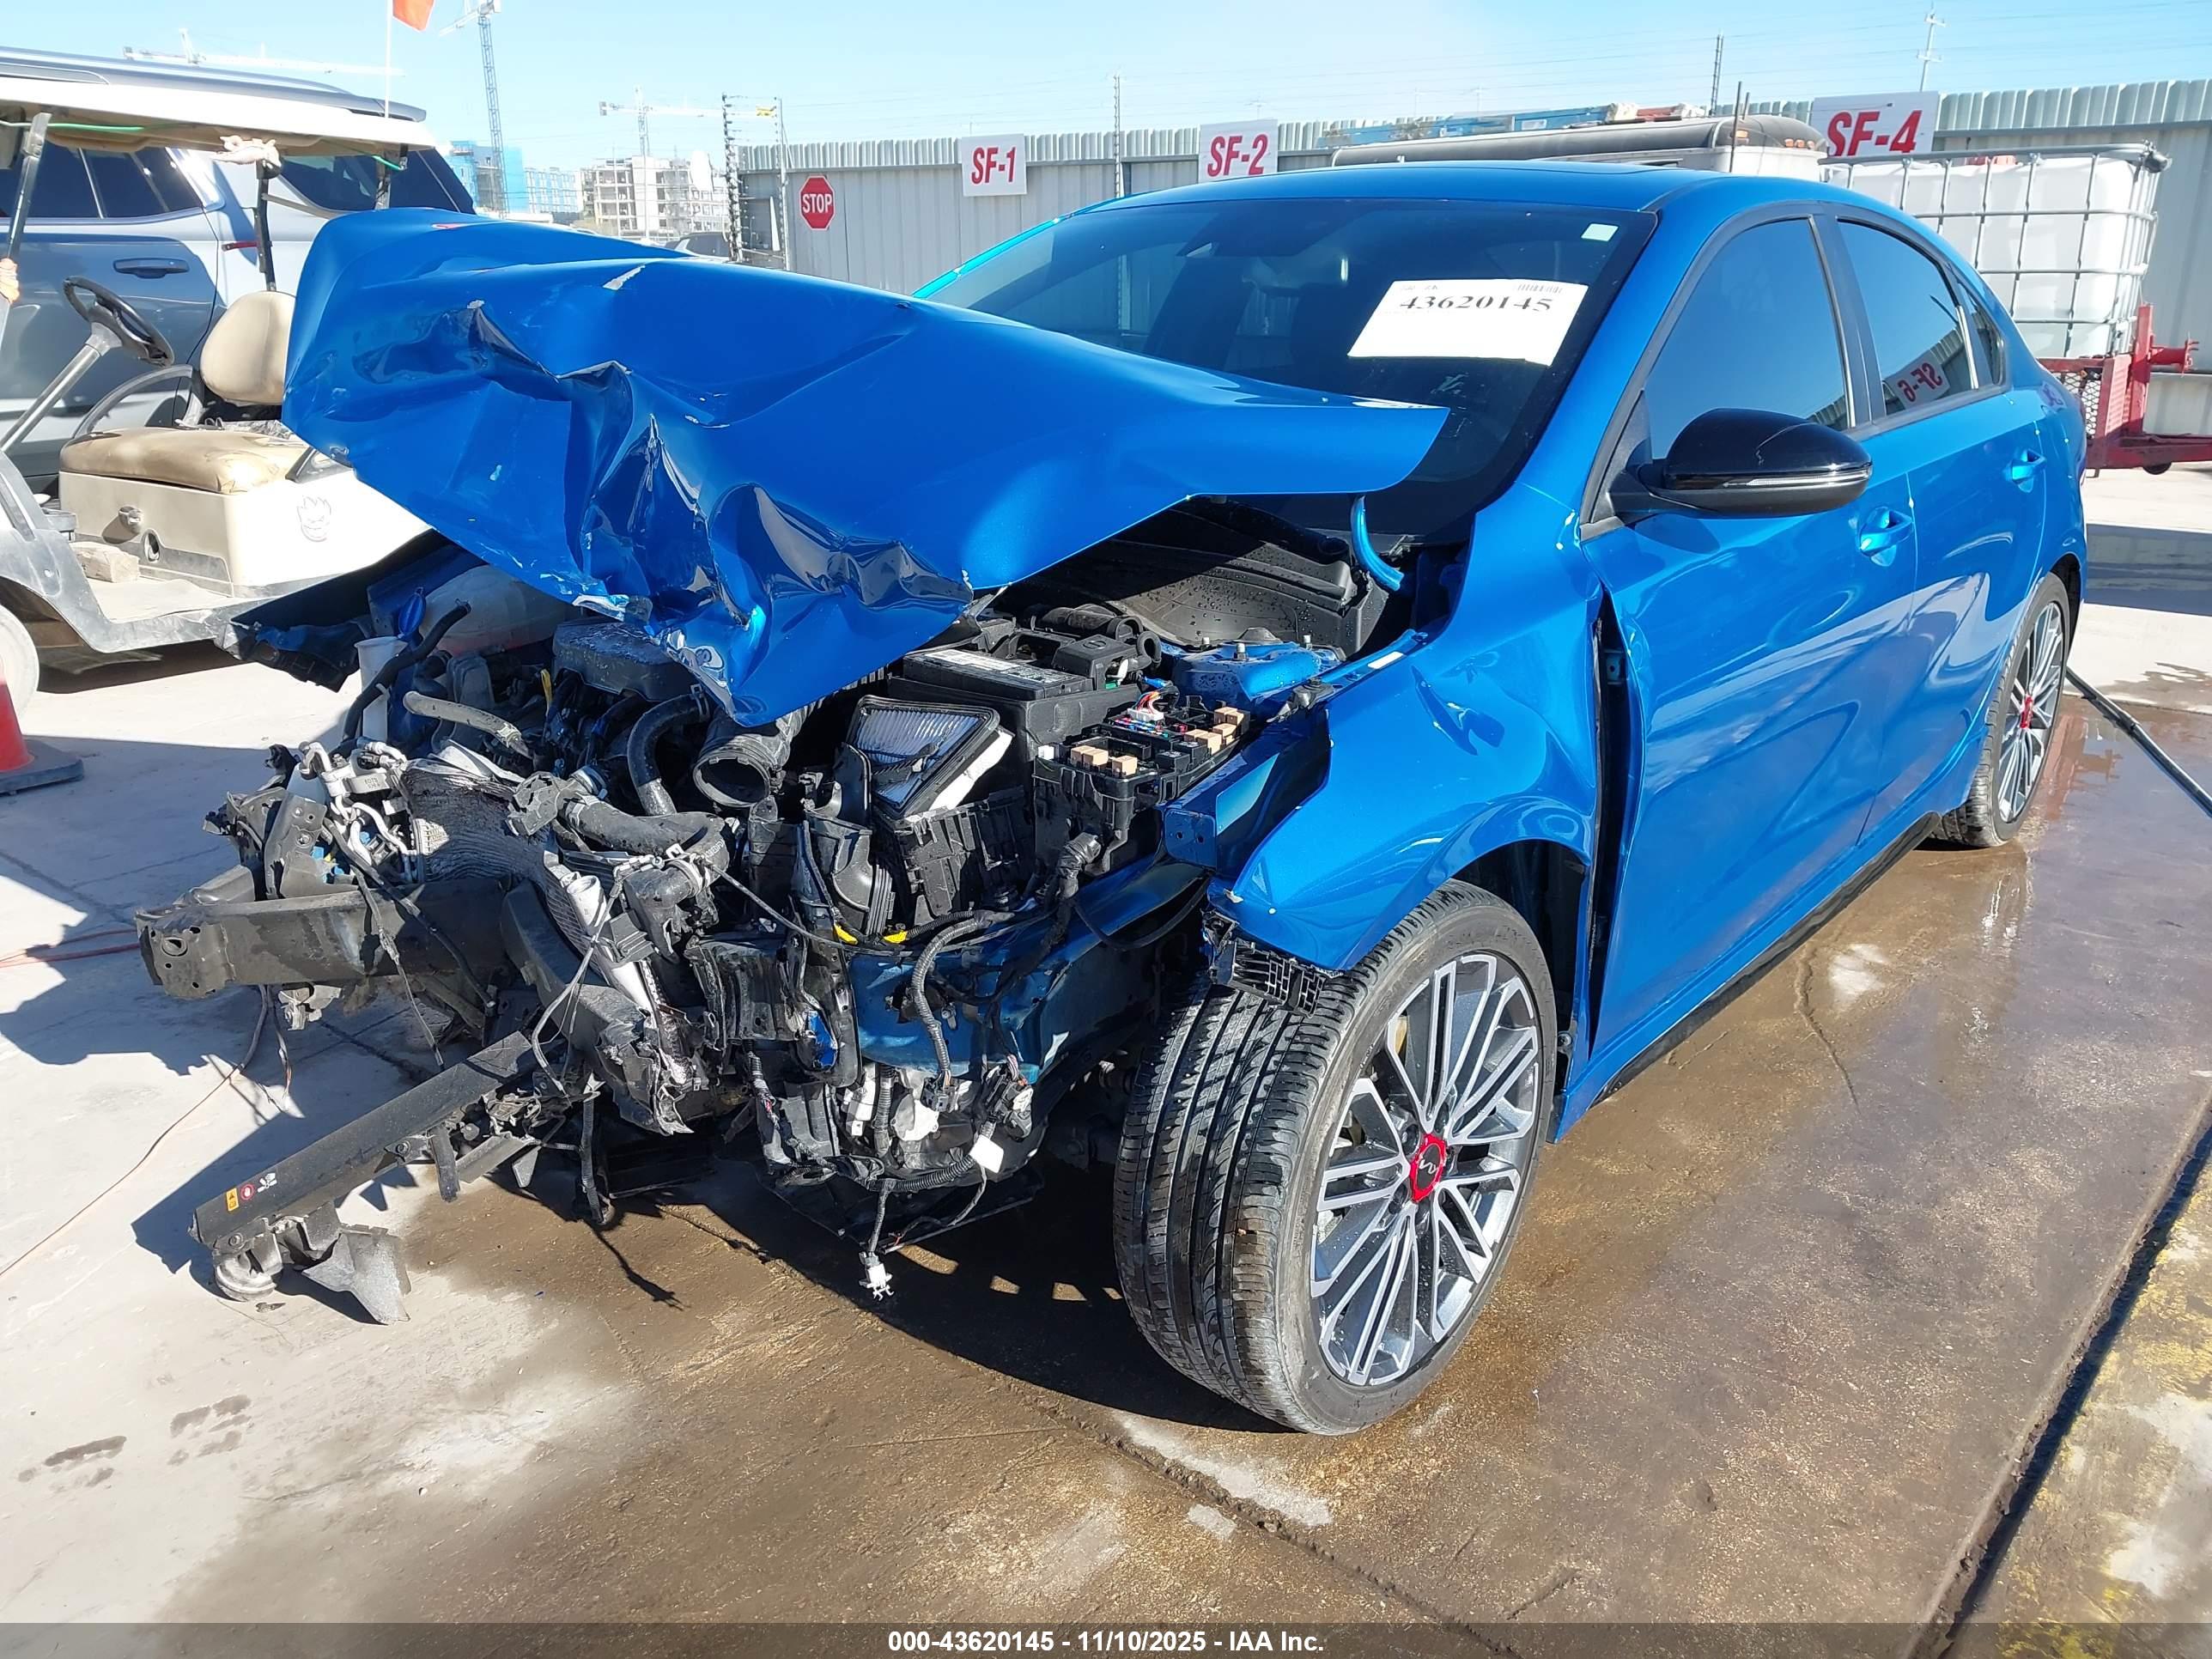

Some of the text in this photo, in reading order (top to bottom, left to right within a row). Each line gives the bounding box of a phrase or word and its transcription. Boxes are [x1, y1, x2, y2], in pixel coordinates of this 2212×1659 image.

[1827, 109, 1923, 156] SF-4
[971, 146, 1017, 185] SF-1
[1207, 133, 1268, 177] SF-2
[802, 193, 833, 214] STOP
[1400, 295, 1554, 312] 43620145
